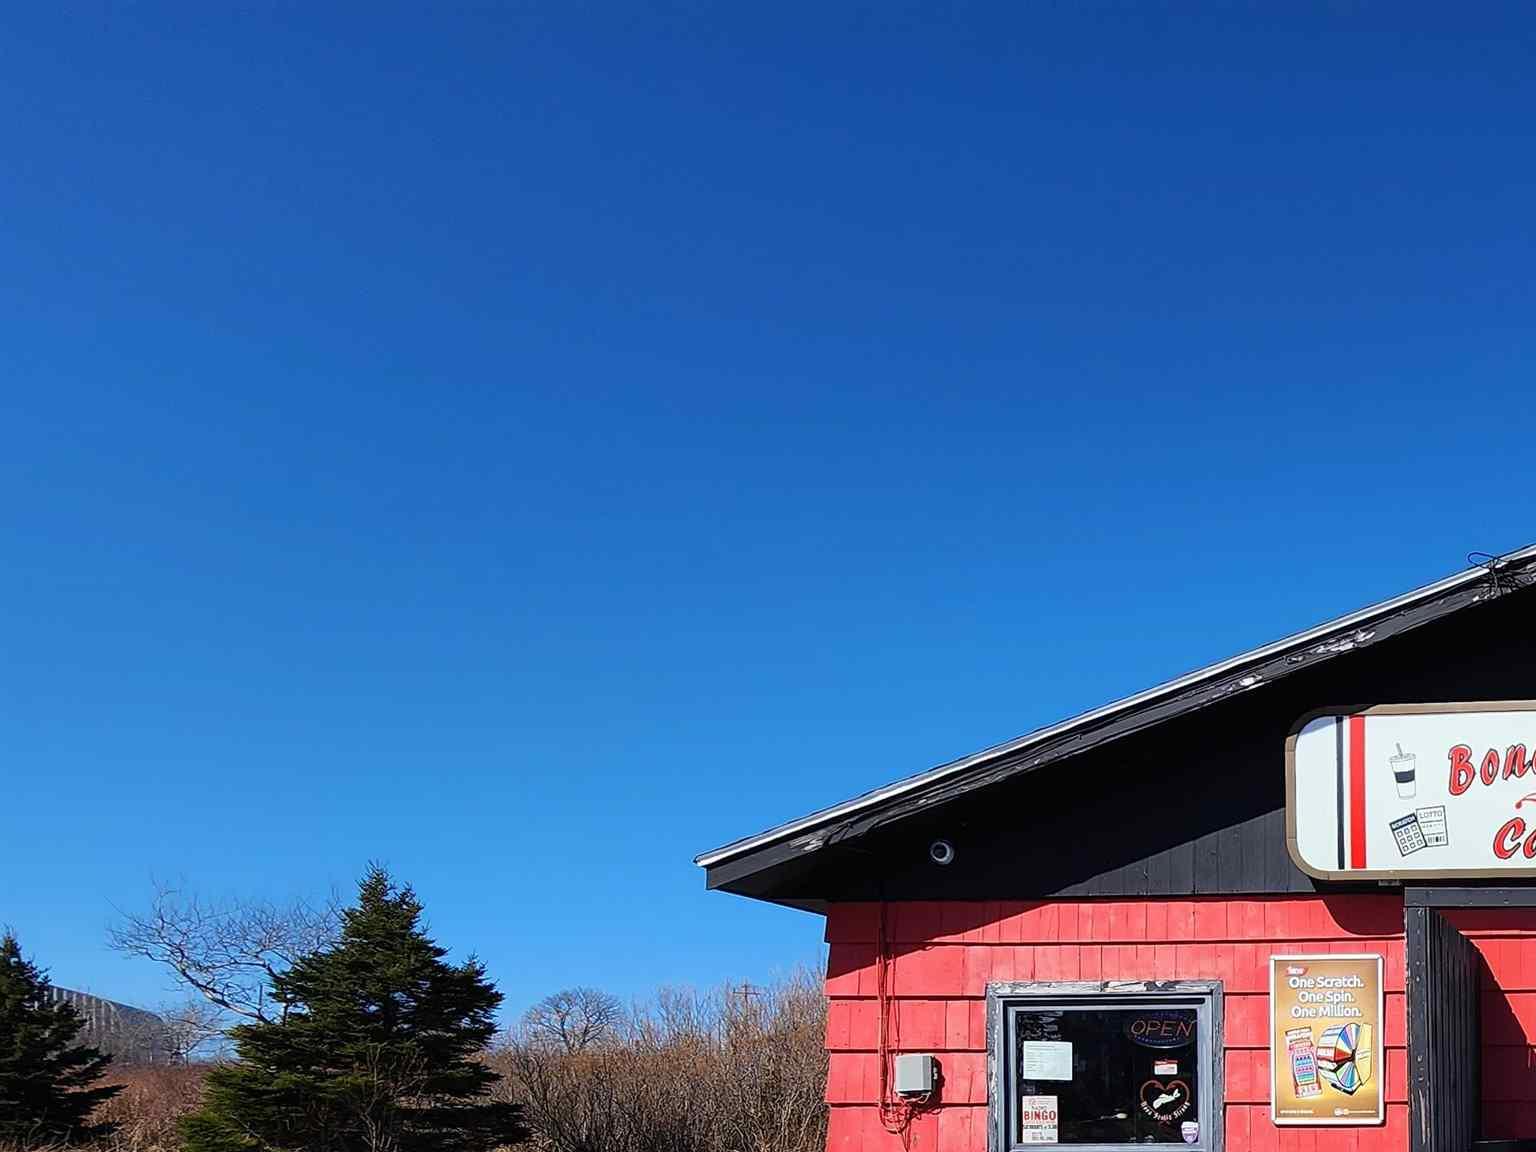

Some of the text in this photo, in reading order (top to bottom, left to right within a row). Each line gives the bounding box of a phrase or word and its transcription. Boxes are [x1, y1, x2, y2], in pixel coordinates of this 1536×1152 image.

[1418, 810, 1443, 819] LOTTO
[1289, 975, 1365, 988] One Scratch.
[1298, 990, 1355, 1004] One Spin.
[1291, 1004, 1363, 1018] One Million.
[1130, 1019, 1194, 1038] OPEN
[1024, 1110, 1056, 1121] BINGO
